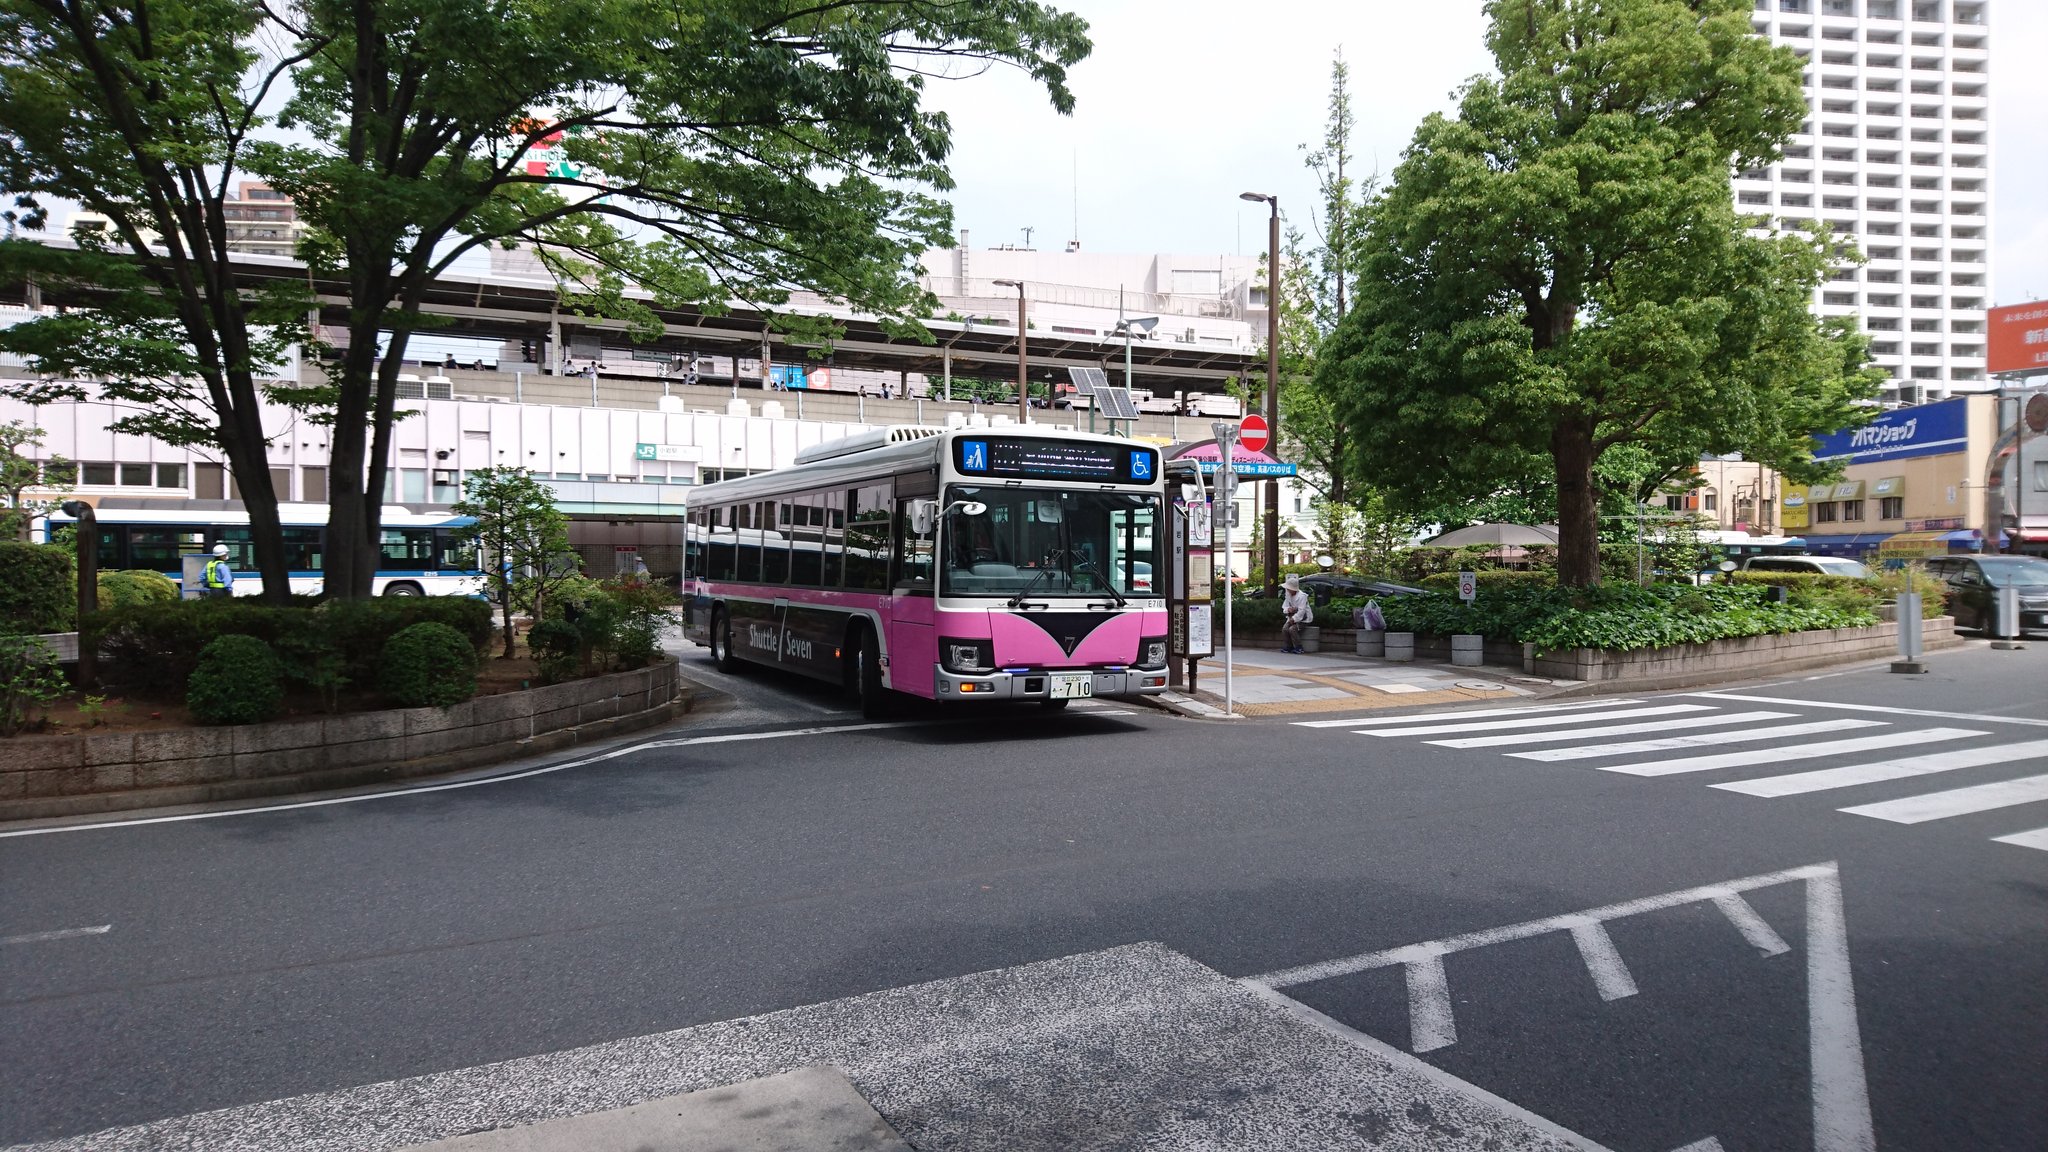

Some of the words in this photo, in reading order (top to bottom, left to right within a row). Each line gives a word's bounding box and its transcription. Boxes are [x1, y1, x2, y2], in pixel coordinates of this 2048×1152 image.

[1851, 418, 1918, 447] アパマンショップ
[638, 446, 655, 455] JR
[1257, 465, 1292, 474] 高速バスのりば
[749, 624, 777, 652] Shuttle
[786, 630, 812, 660] Seven
[1064, 636, 1075, 653] 7
